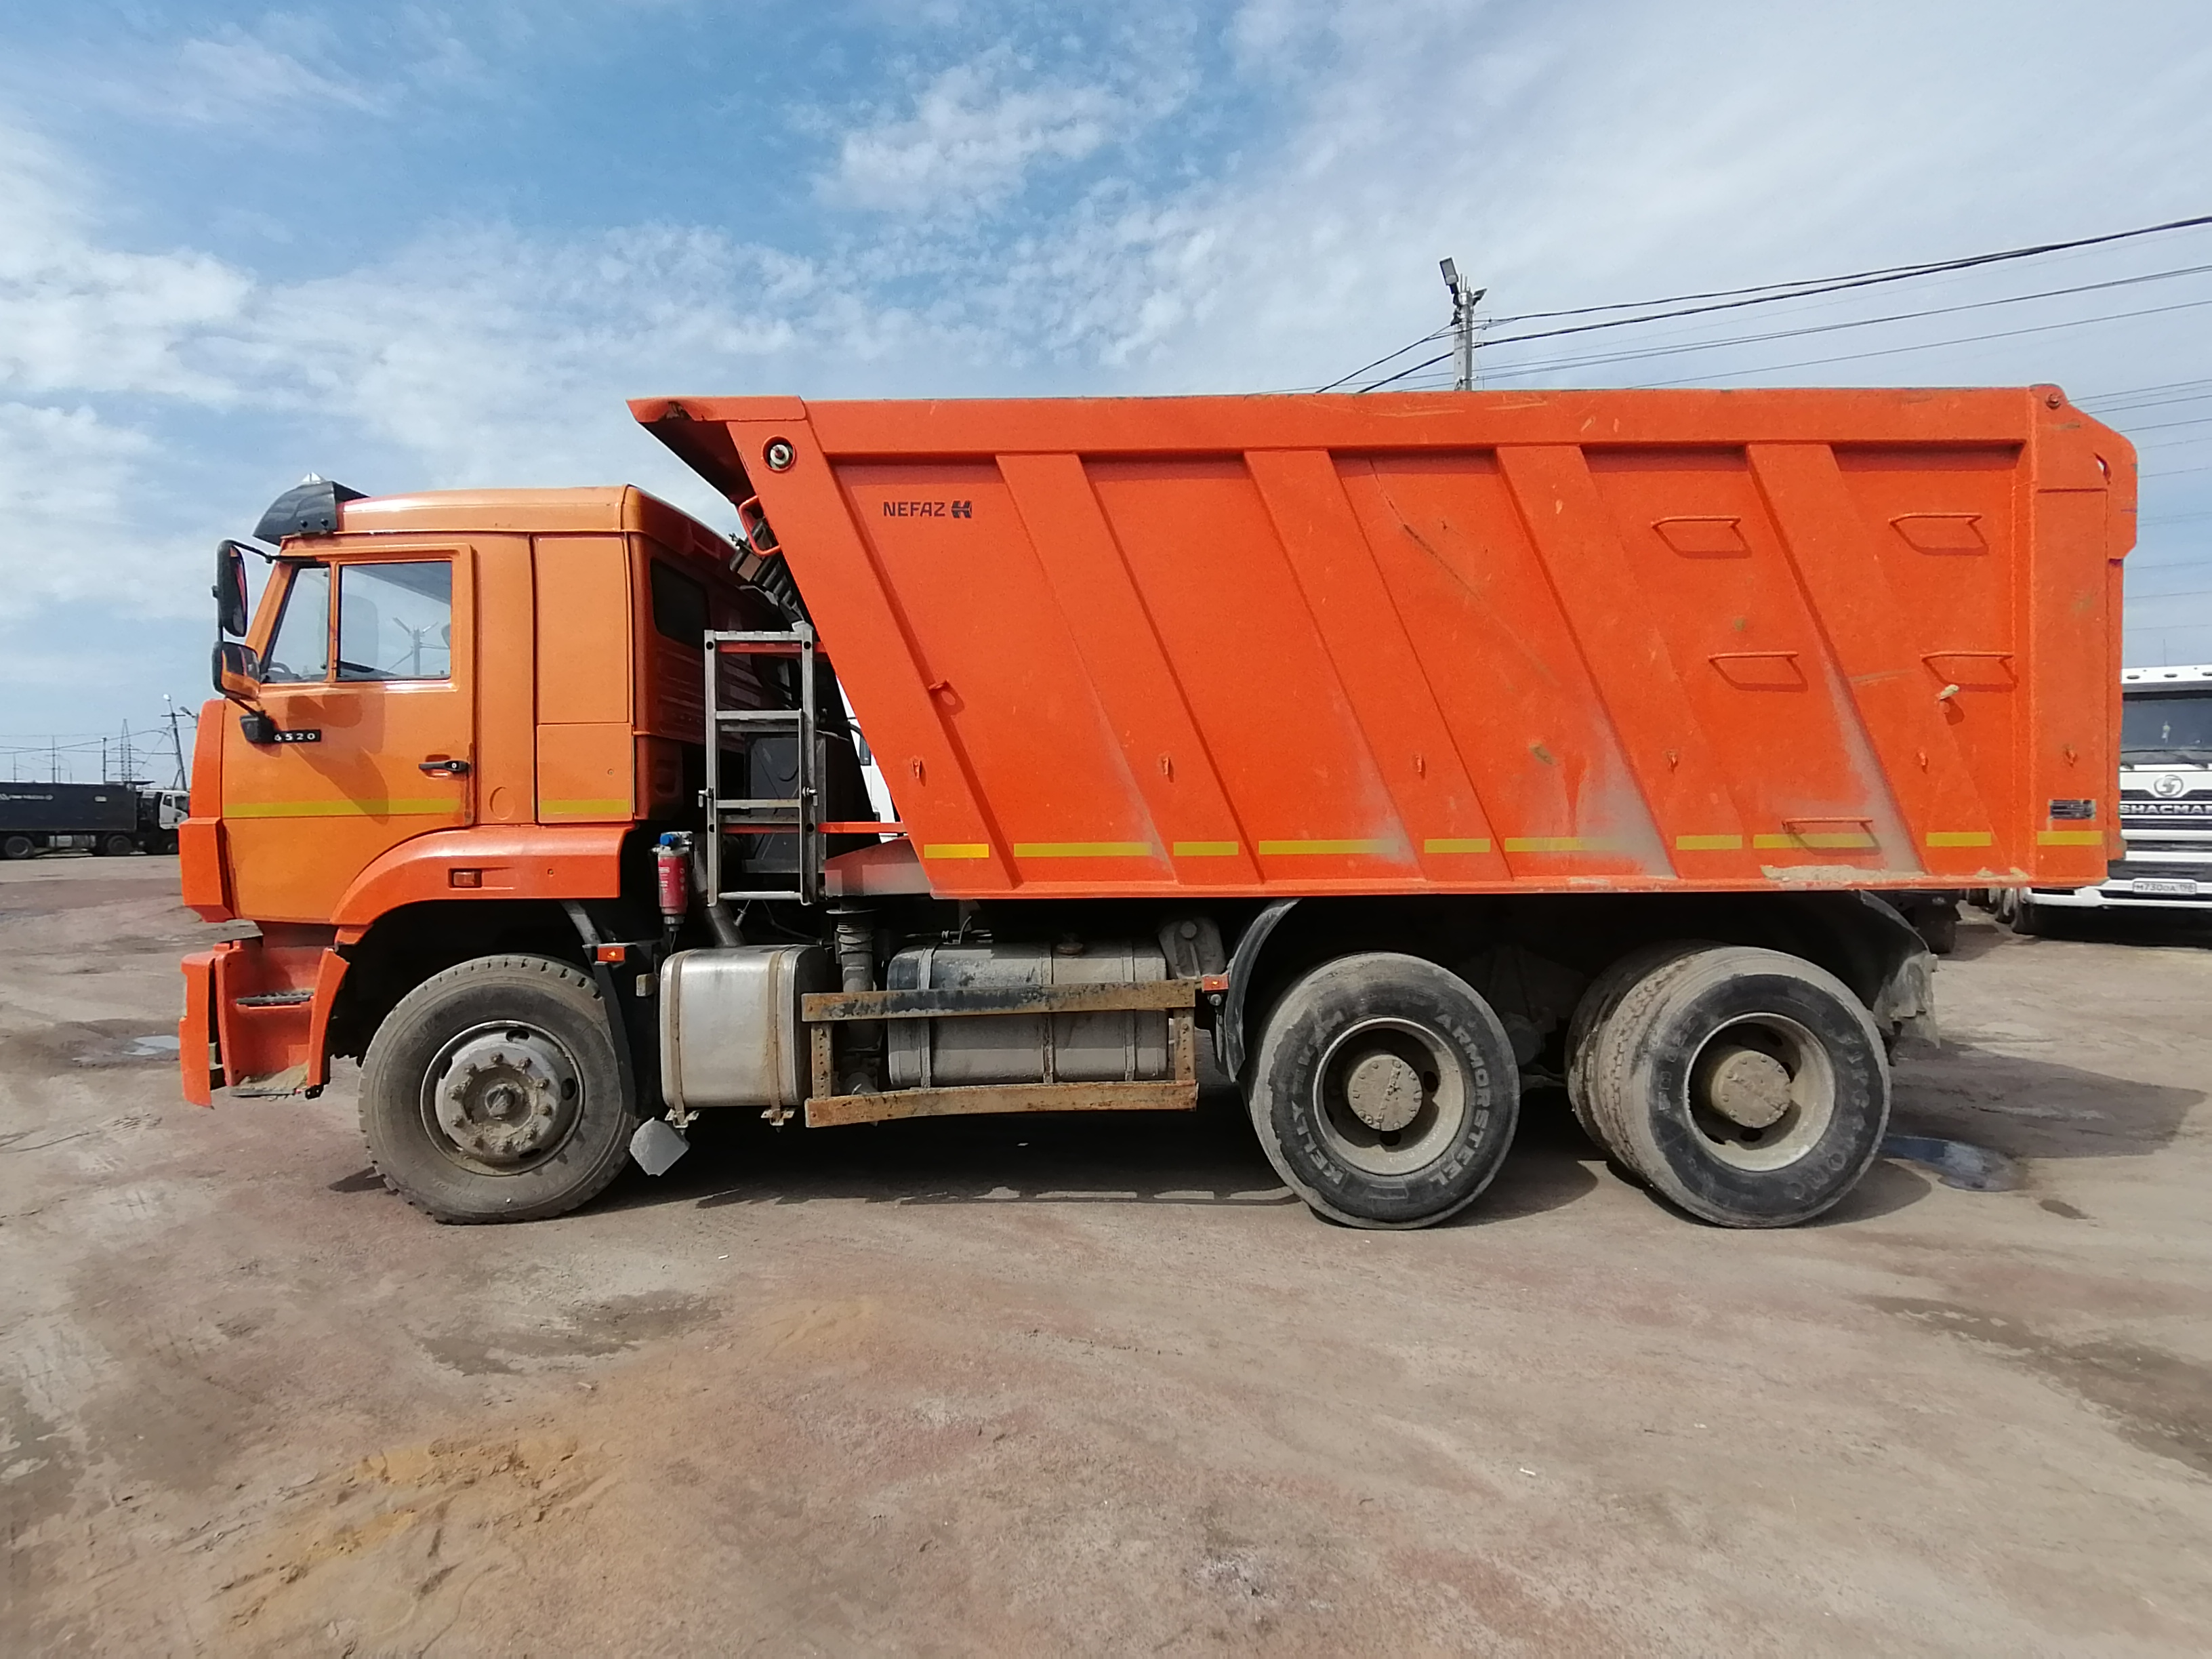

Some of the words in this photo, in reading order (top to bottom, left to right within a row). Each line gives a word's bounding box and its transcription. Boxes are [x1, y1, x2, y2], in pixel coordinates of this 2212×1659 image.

[883, 501, 946, 517] NEFAZ
[274, 733, 316, 741] 6520
[1429, 1014, 1491, 1185] ARMORSTEEL
[1292, 1099, 1344, 1185] KELLY
